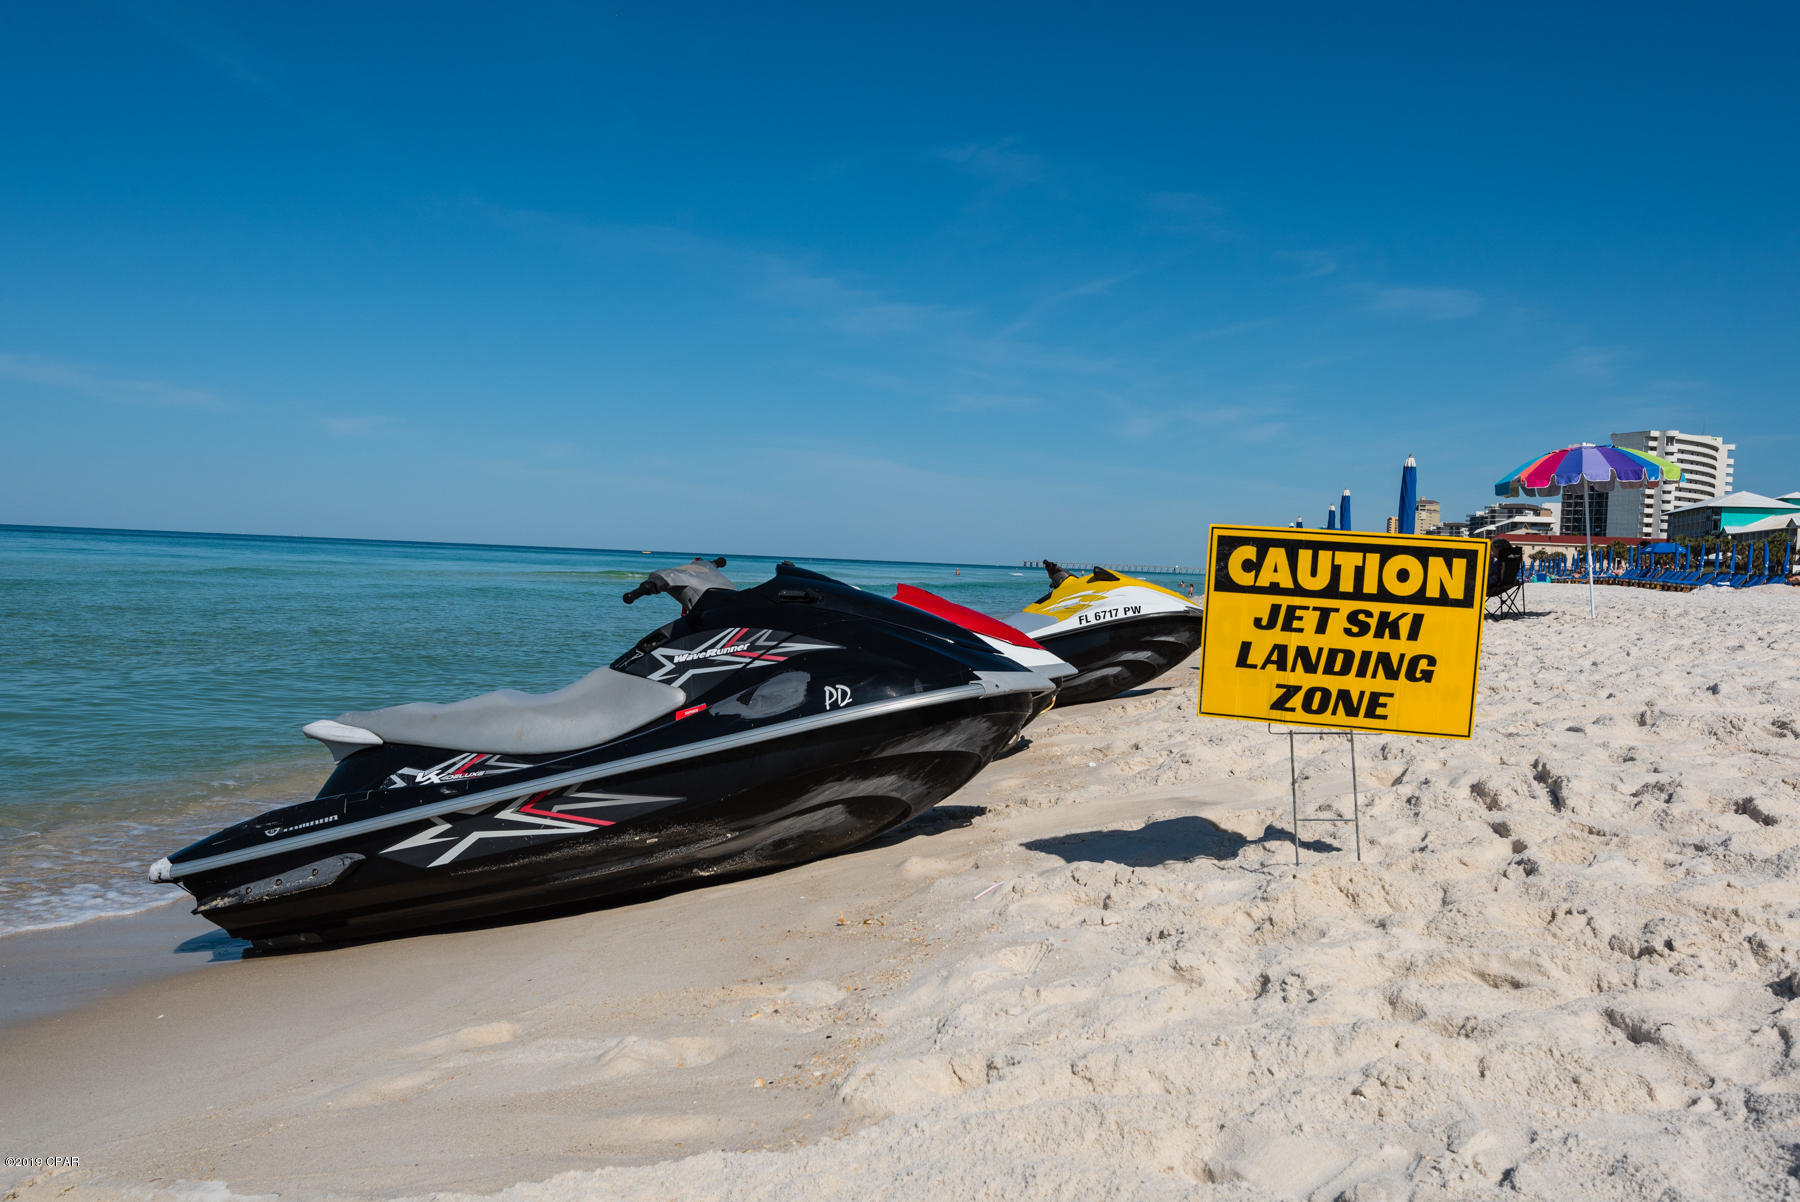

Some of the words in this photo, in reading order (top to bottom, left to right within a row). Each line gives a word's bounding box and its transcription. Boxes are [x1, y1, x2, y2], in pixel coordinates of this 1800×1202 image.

[1227, 544, 1467, 600] CAUTION
[1078, 614, 1091, 625] FL
[1094, 608, 1119, 620] 6717
[1123, 605, 1141, 615] PW
[1253, 603, 1340, 635] JET
[1342, 608, 1425, 642] SKI
[673, 643, 751, 663] WaveRunner
[1235, 640, 1438, 684] LANDING
[1269, 683, 1395, 721] ZONE
